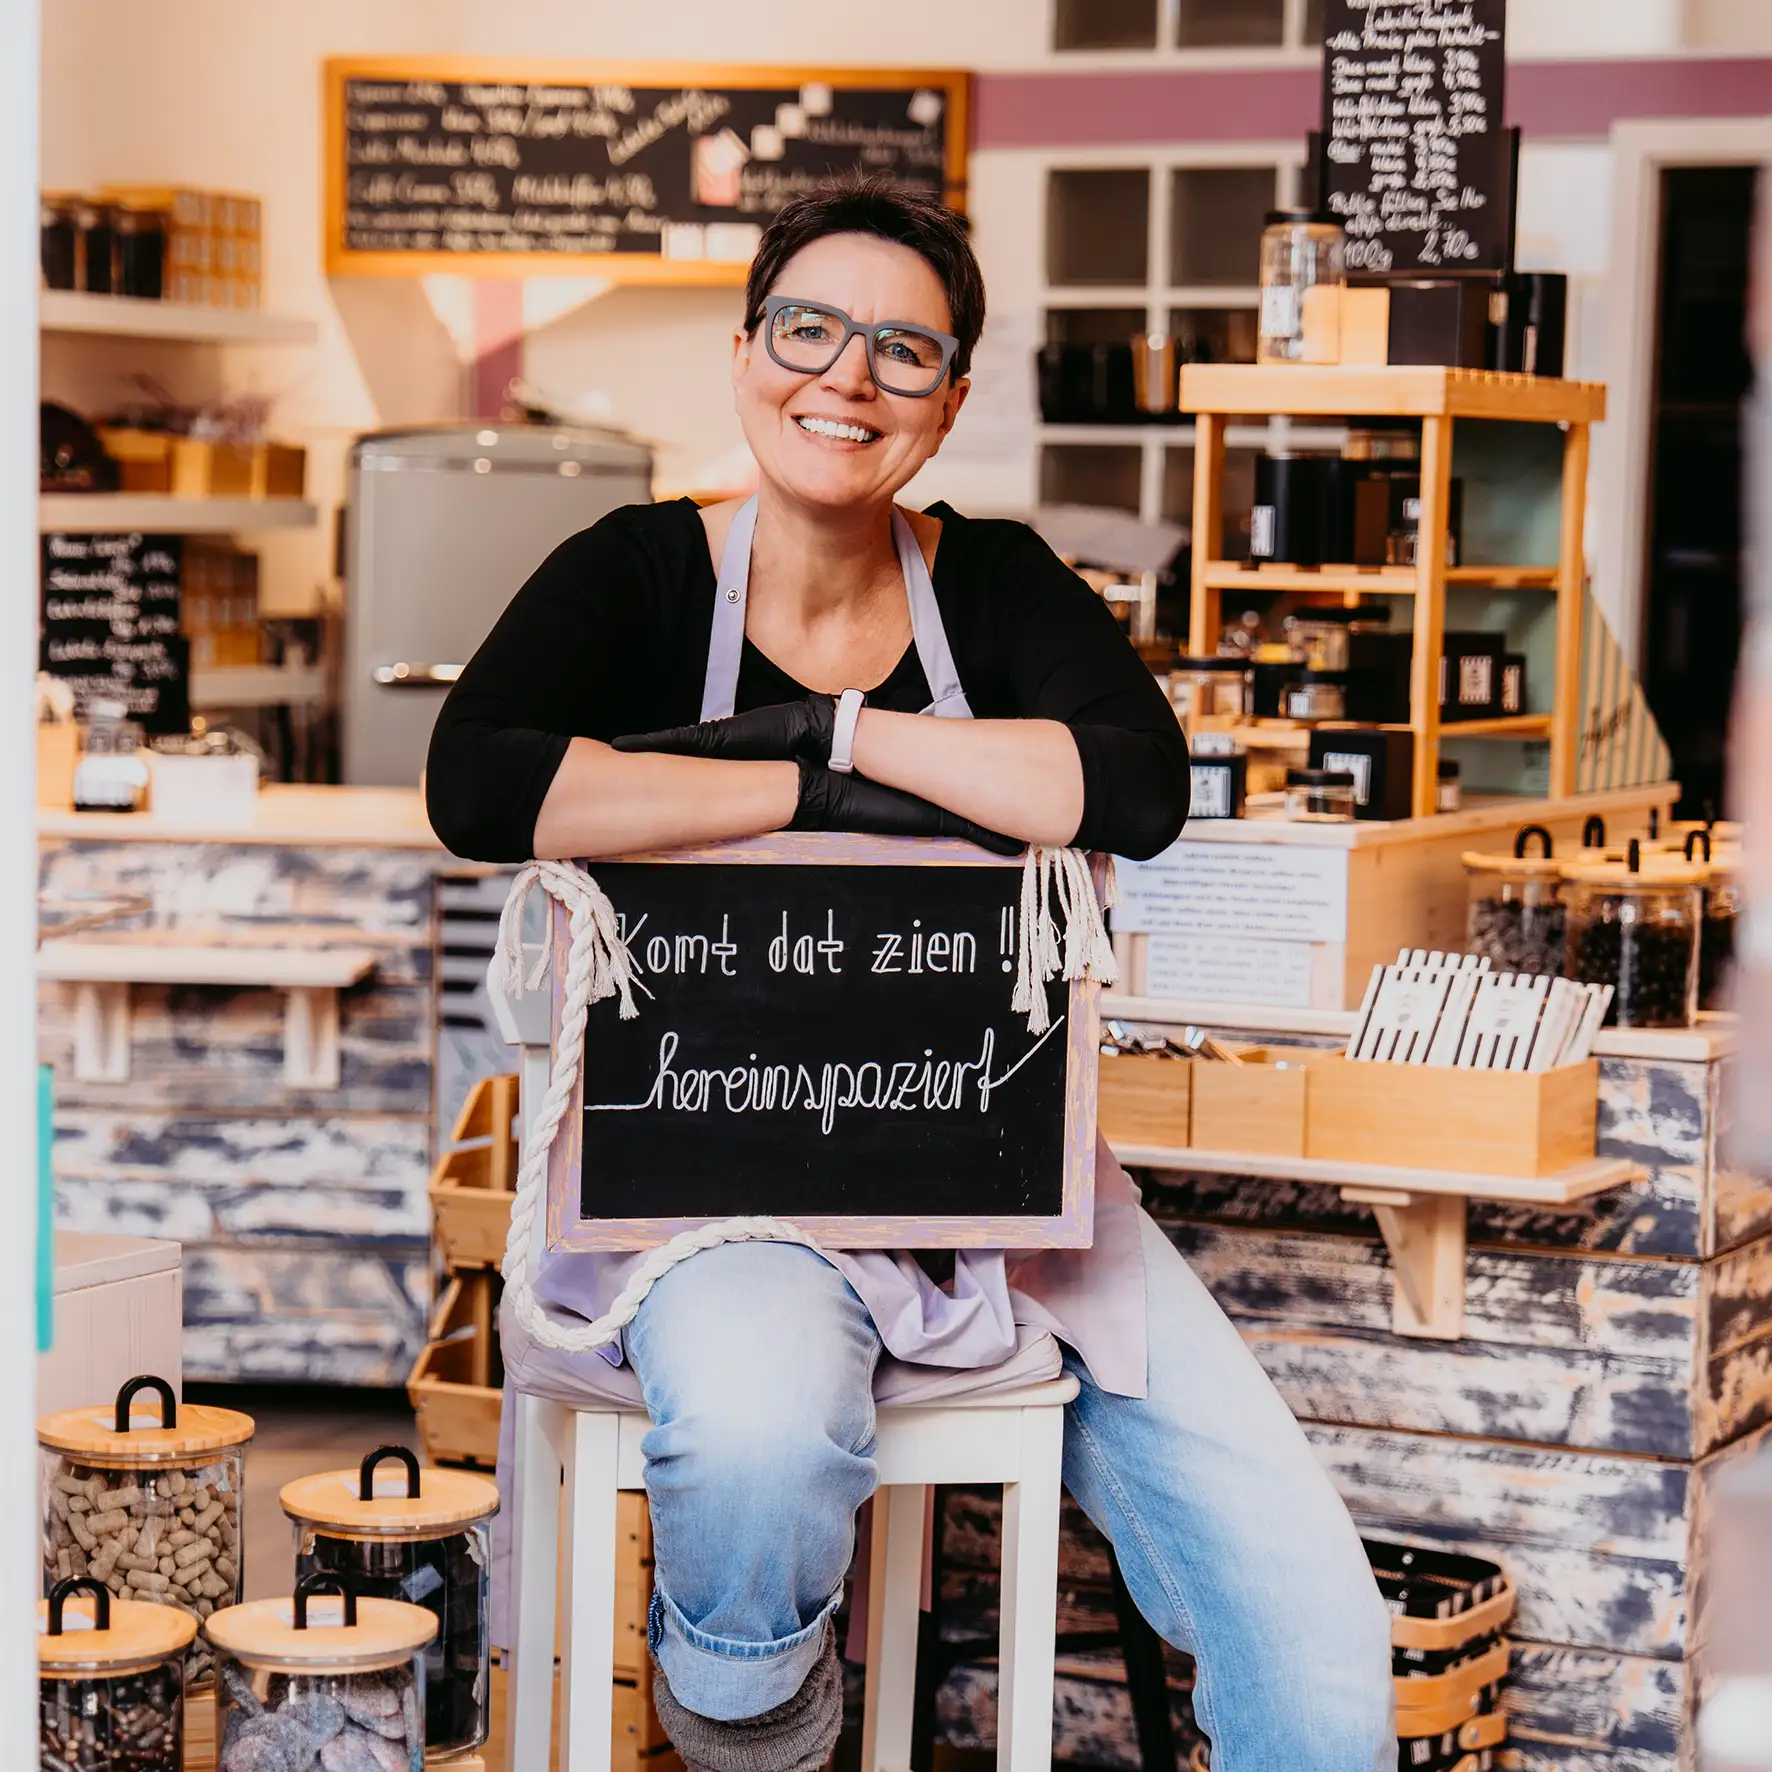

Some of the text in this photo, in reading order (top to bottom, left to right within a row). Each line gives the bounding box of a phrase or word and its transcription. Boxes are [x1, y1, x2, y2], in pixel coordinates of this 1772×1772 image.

[615, 912, 737, 977] Komt
[768, 910, 843, 975] dat
[870, 919, 977, 974] zien
[584, 1016, 1064, 1135] hereinspaziert
